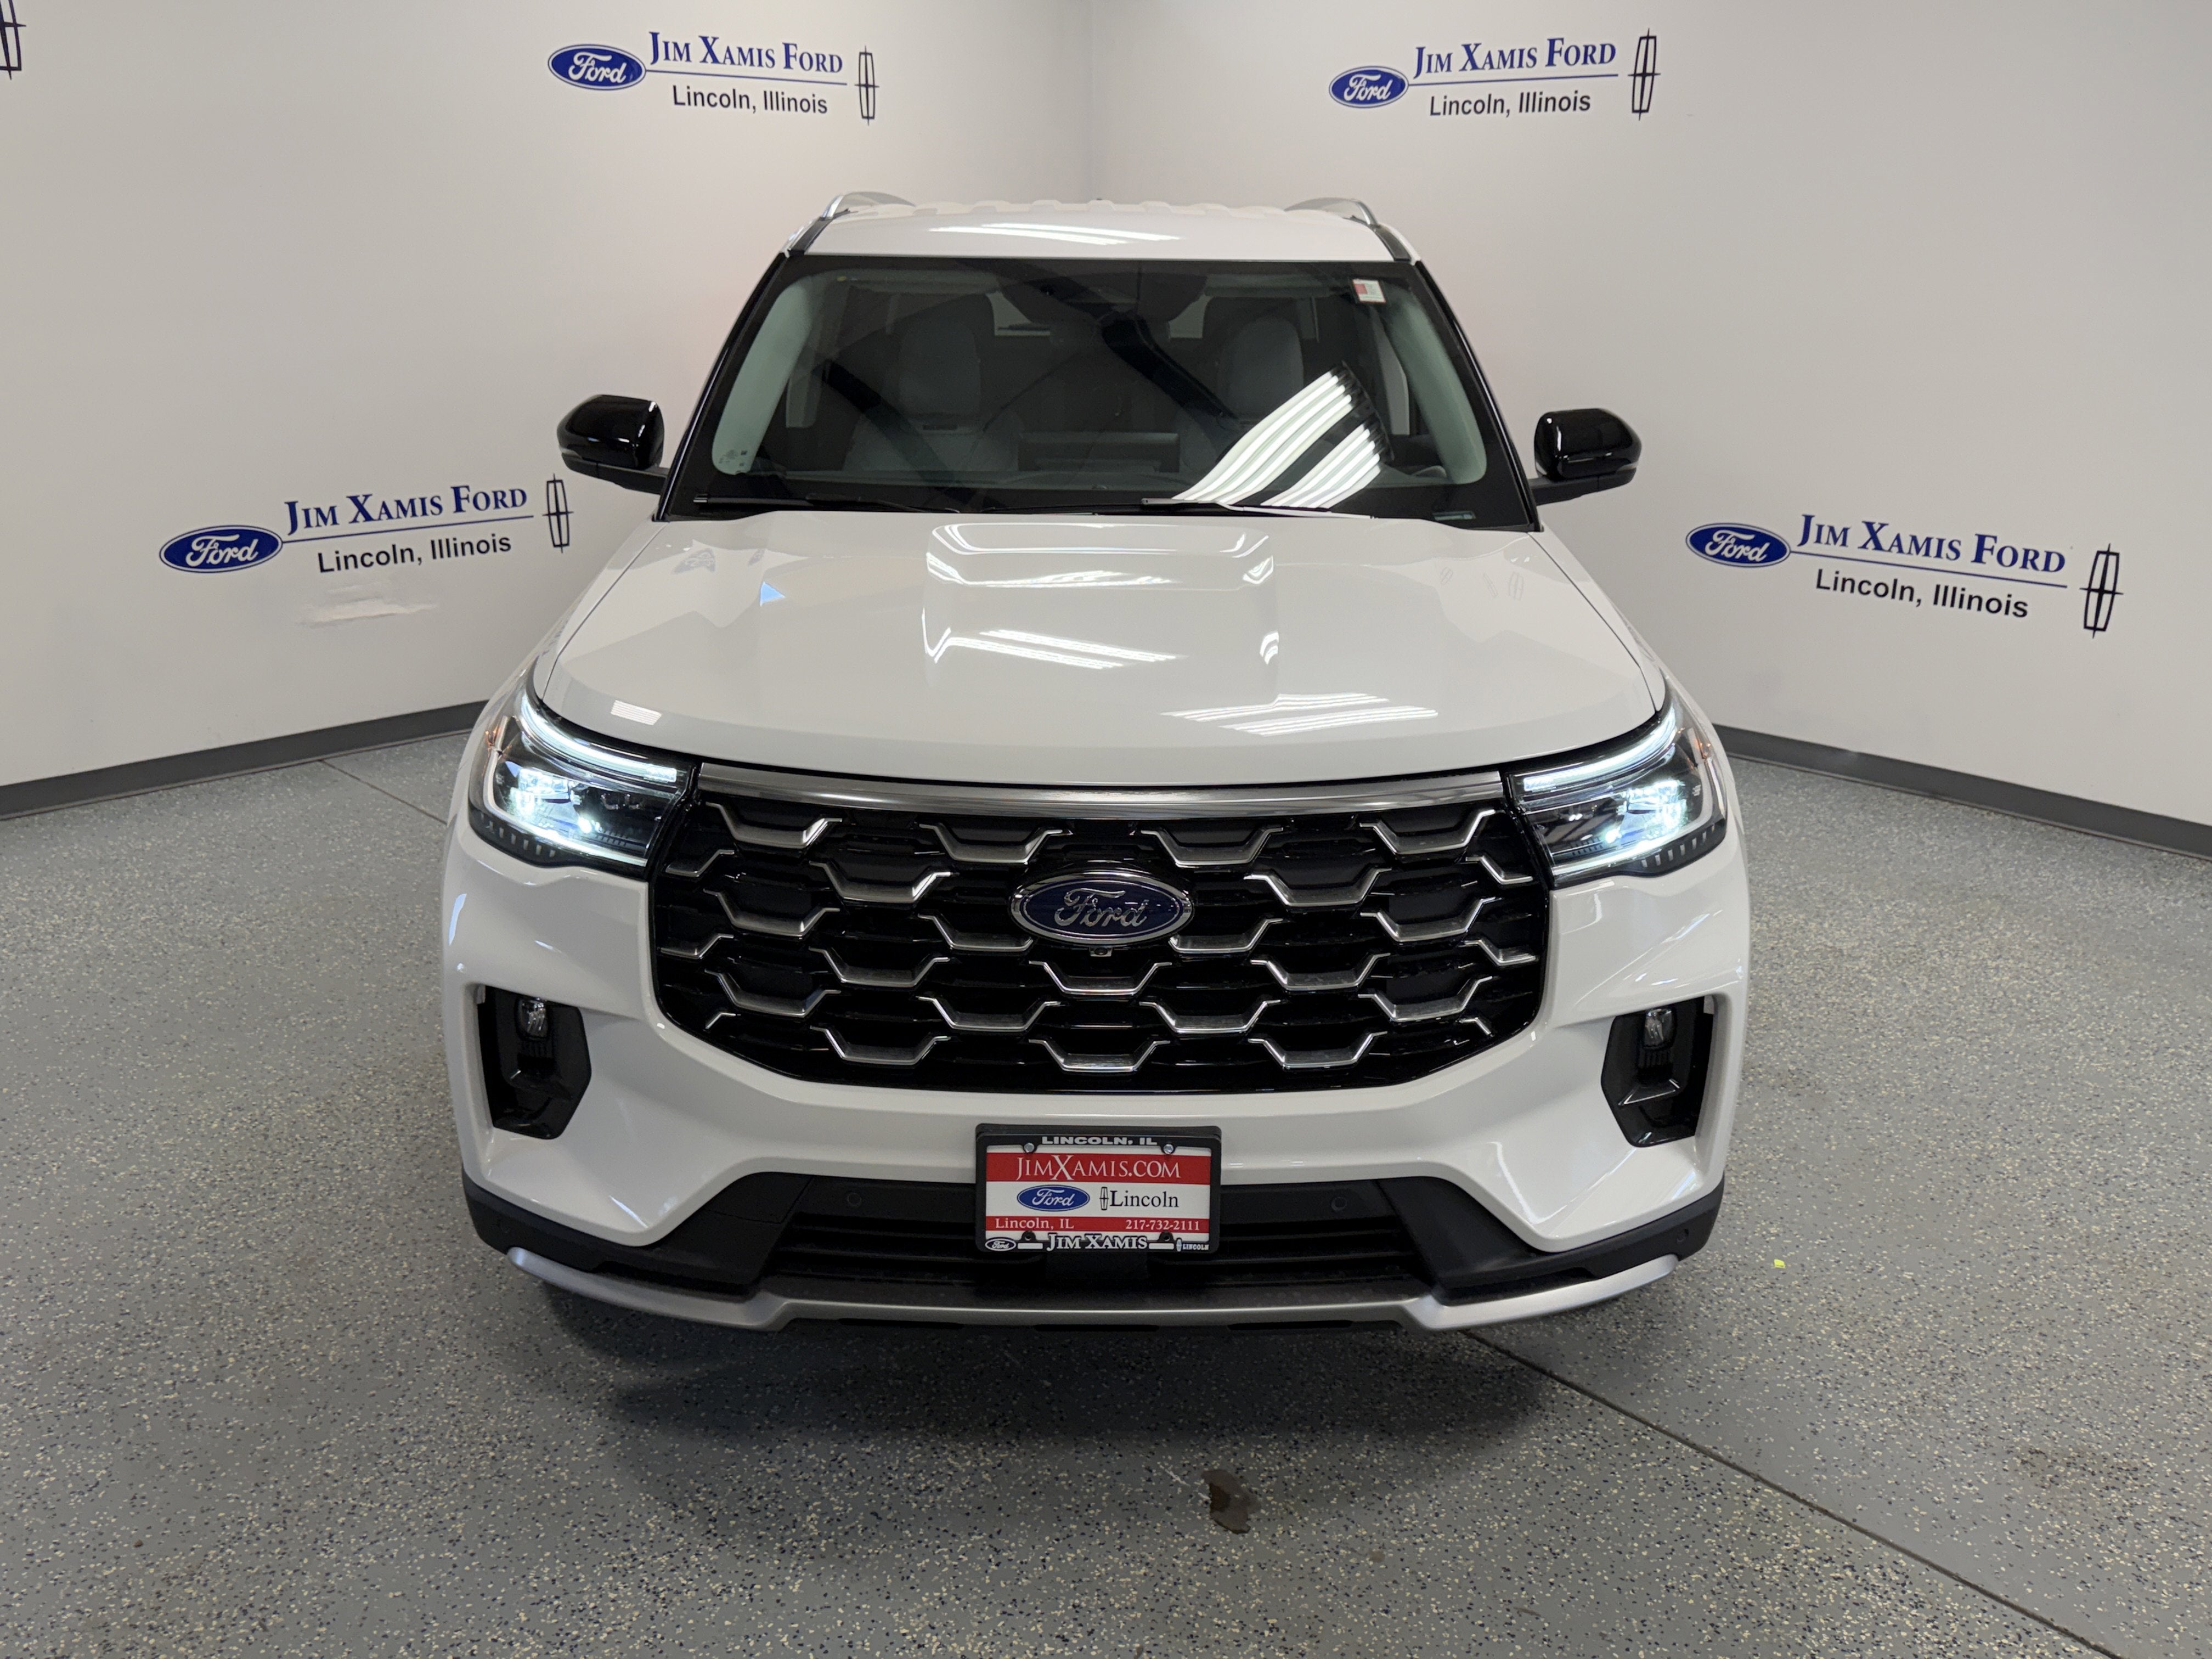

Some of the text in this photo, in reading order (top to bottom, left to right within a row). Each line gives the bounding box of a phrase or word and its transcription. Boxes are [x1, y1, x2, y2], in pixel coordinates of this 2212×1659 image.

[568, 52, 627, 83] Ford
[648, 31, 843, 73] JIM XAMIS FORD
[1413, 37, 1616, 79] JIM XAMIS FORD
[673, 85, 828, 114] Lincoln, Illinois
[1344, 74, 1391, 101] Ford
[1430, 91, 1591, 118] Lincoln, Illinois
[284, 485, 527, 535] JIM XAMIS FORD
[185, 534, 258, 567] Ford
[318, 533, 511, 573] Lincoln, Illinois
[1705, 529, 1768, 563] Ford
[1797, 514, 2066, 573] JIM XAMIS FORD
[1815, 568, 2029, 618] Lincoln, Illinois
[1054, 888, 1149, 927] Ford
[1032, 1188, 1075, 1206] Ford
[1110, 1190, 1180, 1207] Lincoln
[995, 1218, 1074, 1230] Lincoln, IL
[1126, 1220, 1200, 1231] 217-732-2111
[991, 1240, 1010, 1249] Ford
[1046, 1233, 1148, 1251] JIM XAMIS
